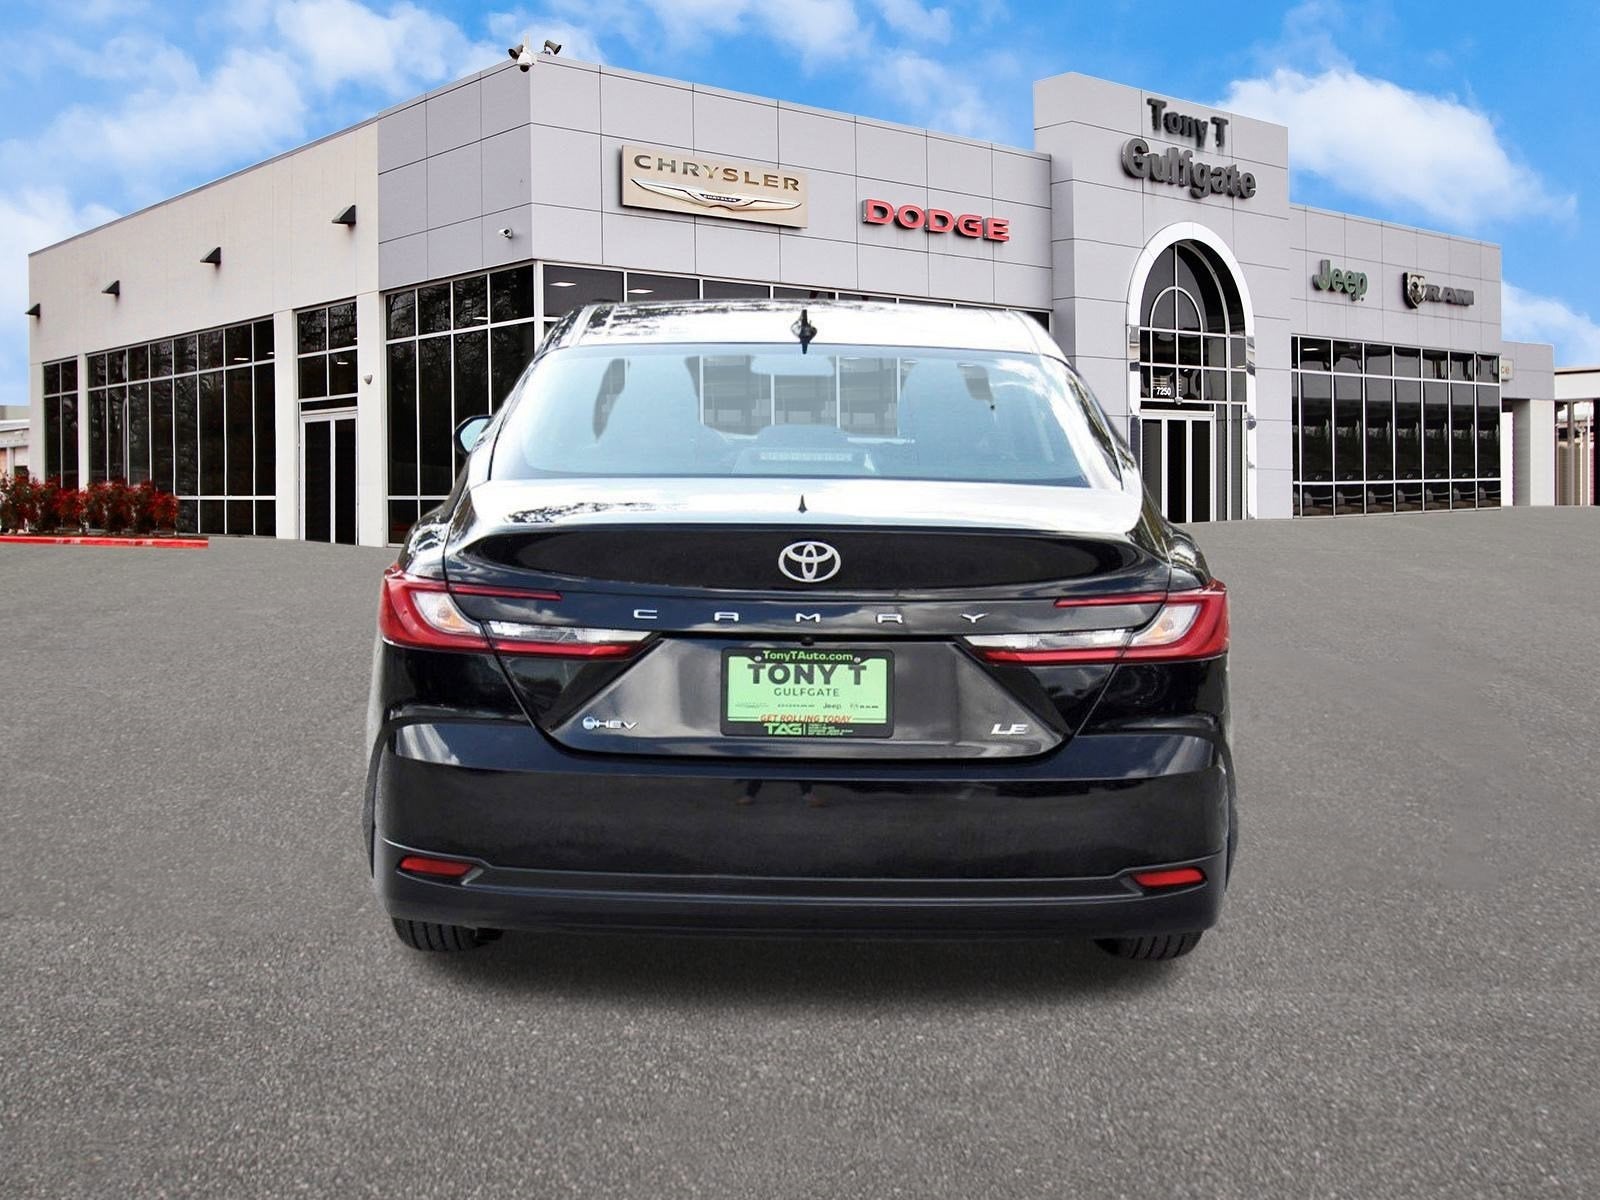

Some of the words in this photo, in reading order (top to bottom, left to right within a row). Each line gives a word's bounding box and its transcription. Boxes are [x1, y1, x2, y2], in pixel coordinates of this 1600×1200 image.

[1146, 98, 1208, 147] Tony
[1210, 116, 1229, 147] T
[633, 154, 800, 192] CHRYSLER
[1121, 137, 1256, 199] Gulfgate
[862, 198, 1010, 242] DODGE
[1312, 259, 1368, 302] Jeep
[1424, 284, 1475, 306] RAM
[1156, 386, 1171, 396] 7250
[633, 608, 989, 624] CAMRY
[763, 650, 853, 662] TonyTAuto.com
[747, 663, 838, 685] TONY
[847, 664, 867, 685] T
[774, 687, 840, 697] GULFGATE
[760, 714, 777, 723] GET
[780, 714, 820, 723] ROLLING
[823, 715, 852, 724] TODAY
[991, 723, 1029, 735] LE
